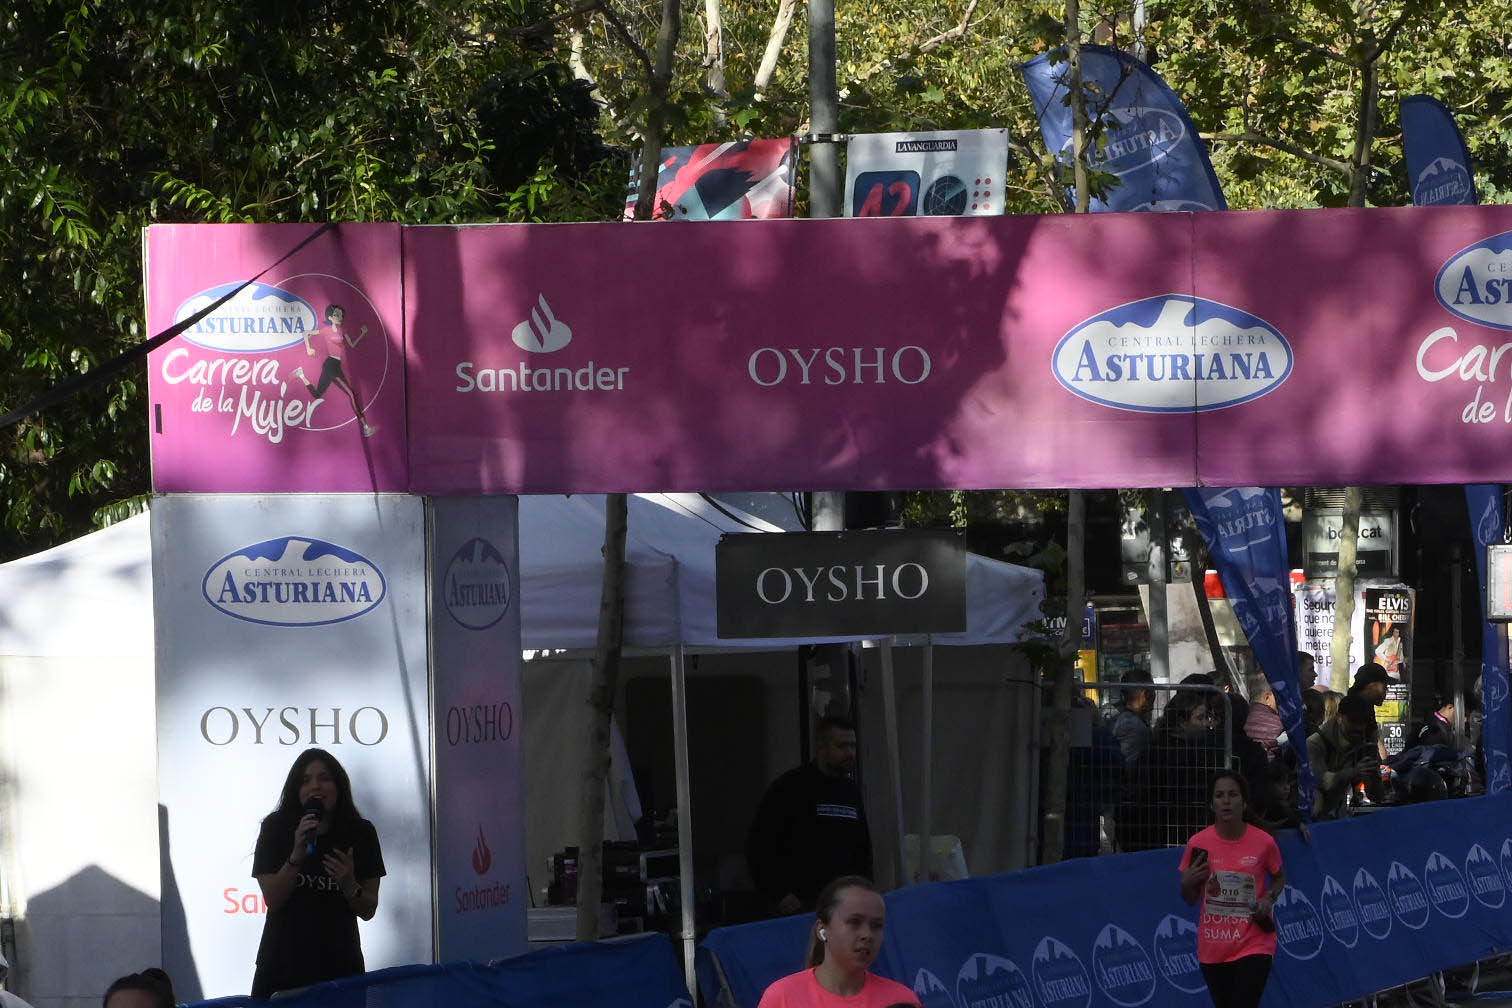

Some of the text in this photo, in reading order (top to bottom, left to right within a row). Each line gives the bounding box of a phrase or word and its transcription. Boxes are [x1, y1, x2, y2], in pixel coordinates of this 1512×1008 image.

[1108, 334, 1267, 347] CENTRAL LECHERA
[161, 348, 280, 385] Carrera
[455, 362, 629, 393] Santander
[747, 346, 933, 387] OYSHO
[1071, 340, 1275, 382] ASTURIANA
[191, 381, 326, 443] de la Mujer
[1461, 385, 1498, 424] de
[217, 570, 373, 605] ASTURIANA
[244, 567, 366, 578] CENTRAL LECHERA
[756, 562, 930, 605] OYSHO
[449, 573, 507, 609] ASTURIANA
[1378, 597, 1409, 610] ELVIS
[199, 706, 389, 747] OYSHO
[447, 702, 513, 747] OYSHO
[1389, 727, 1402, 737] 30
[455, 883, 512, 914] Santander
[1204, 928, 1241, 939] SUMA
